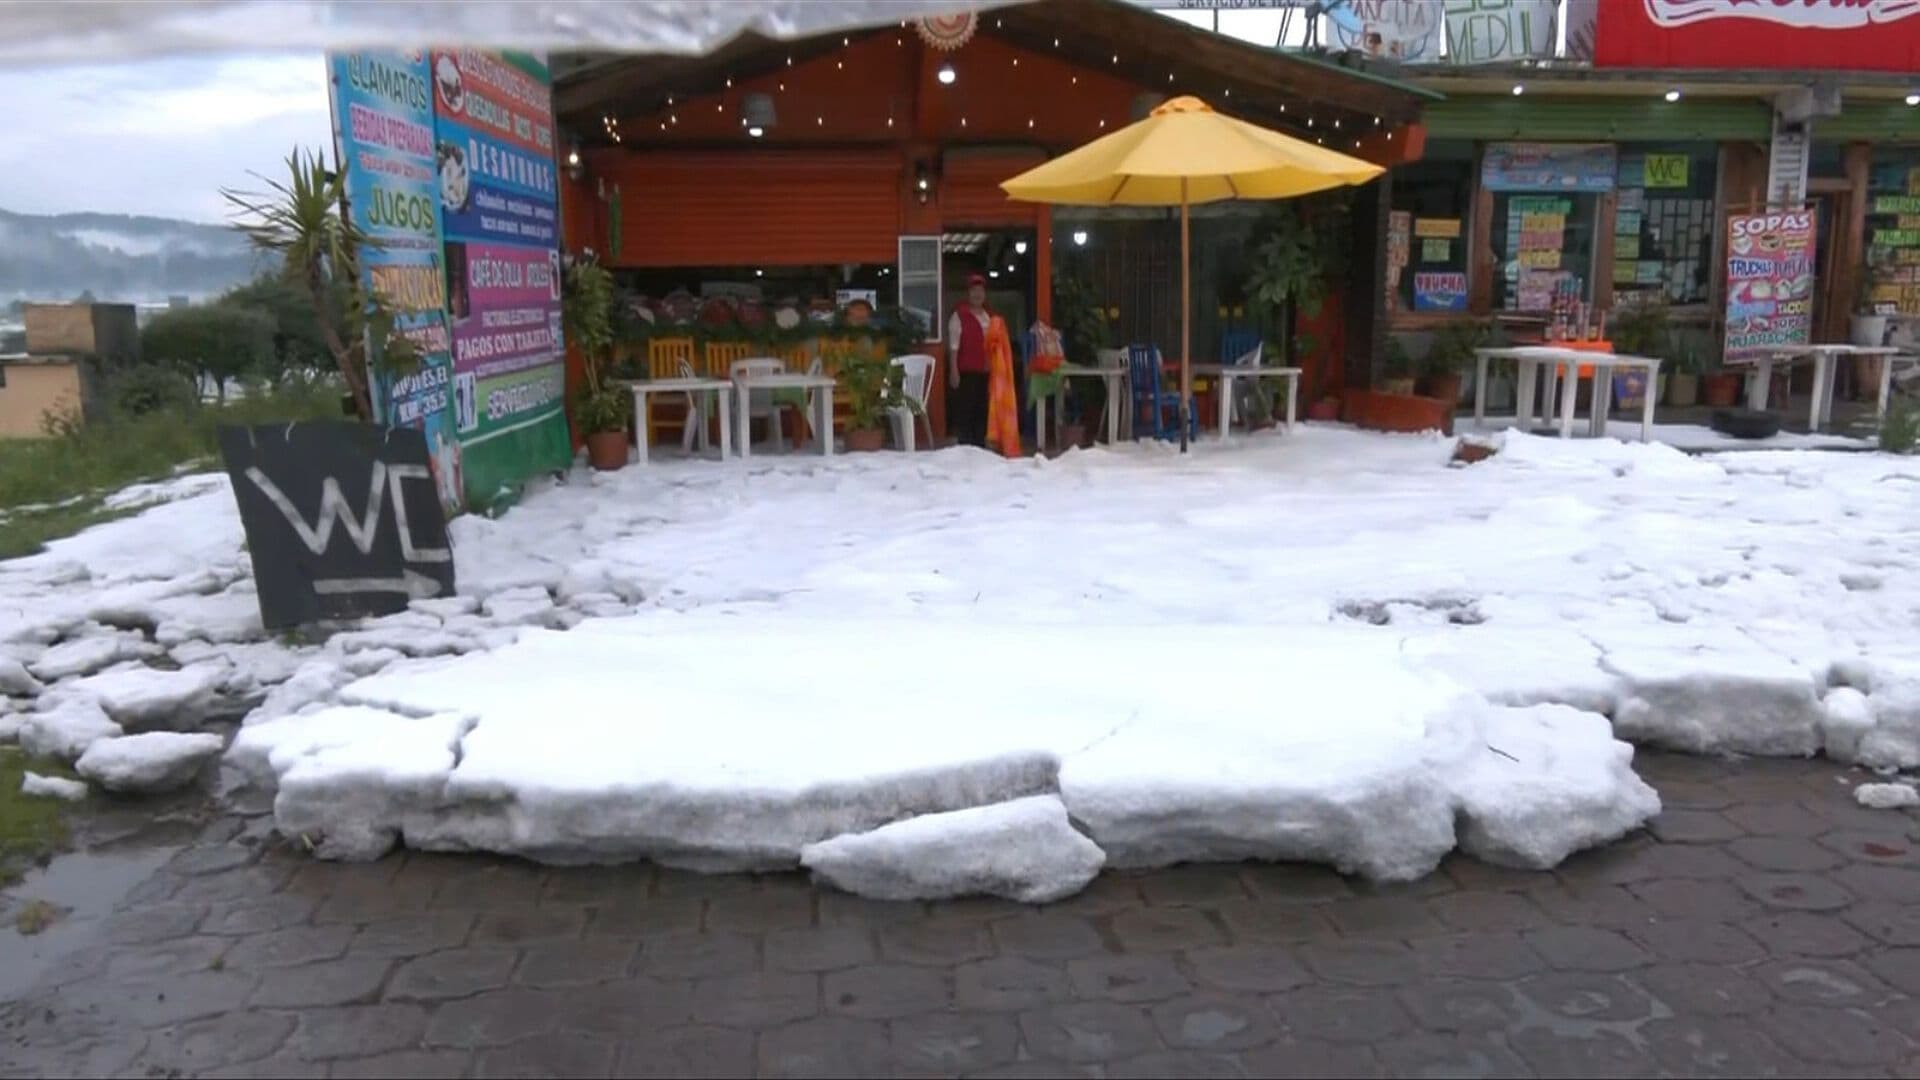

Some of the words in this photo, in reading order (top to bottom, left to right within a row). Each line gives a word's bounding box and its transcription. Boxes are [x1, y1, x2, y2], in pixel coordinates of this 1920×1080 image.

[1649, 157, 1684, 181] WC
[368, 184, 434, 231] JUGOS
[1731, 213, 1811, 238] SOPAS
[457, 335, 493, 361] PAGOS
[494, 332, 515, 354] CON
[244, 459, 451, 563] WC
